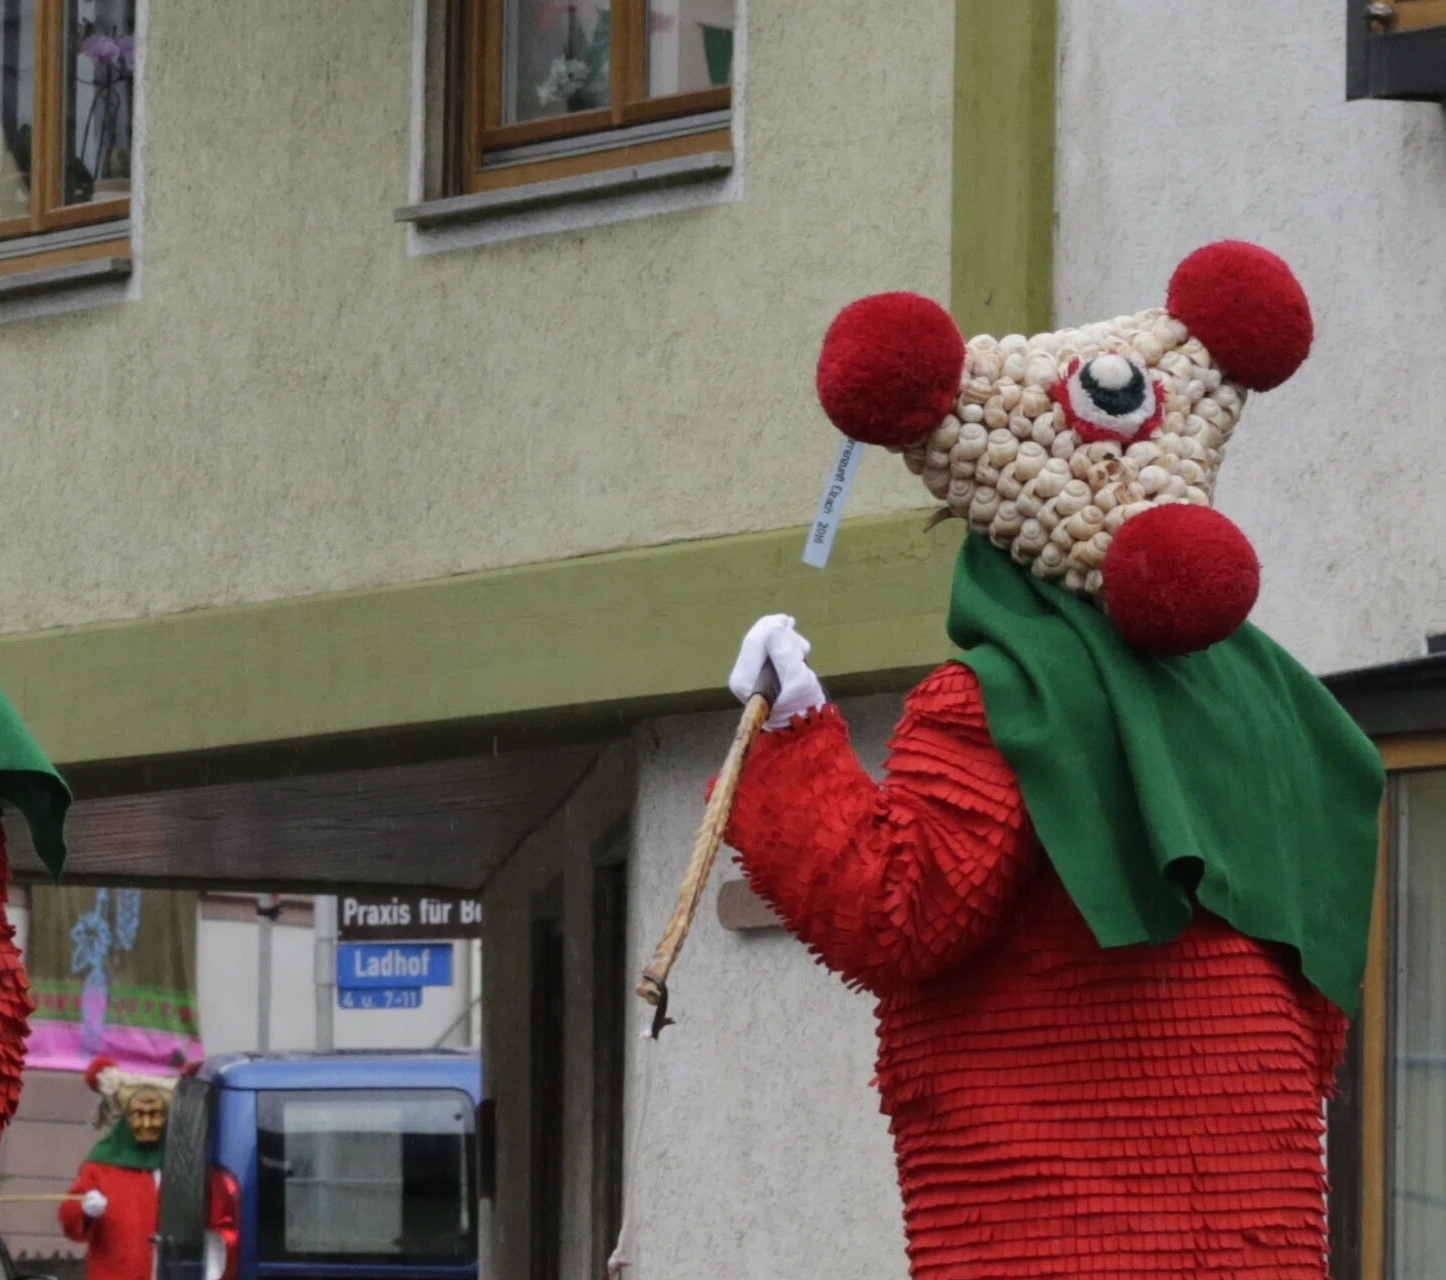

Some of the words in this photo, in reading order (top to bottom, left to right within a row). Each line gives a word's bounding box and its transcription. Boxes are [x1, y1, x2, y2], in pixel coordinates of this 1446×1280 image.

[343, 897, 411, 926] Praxis
[419, 897, 453, 924] für
[355, 948, 430, 977] Ladhof
[383, 990, 417, 1008] 7-11
